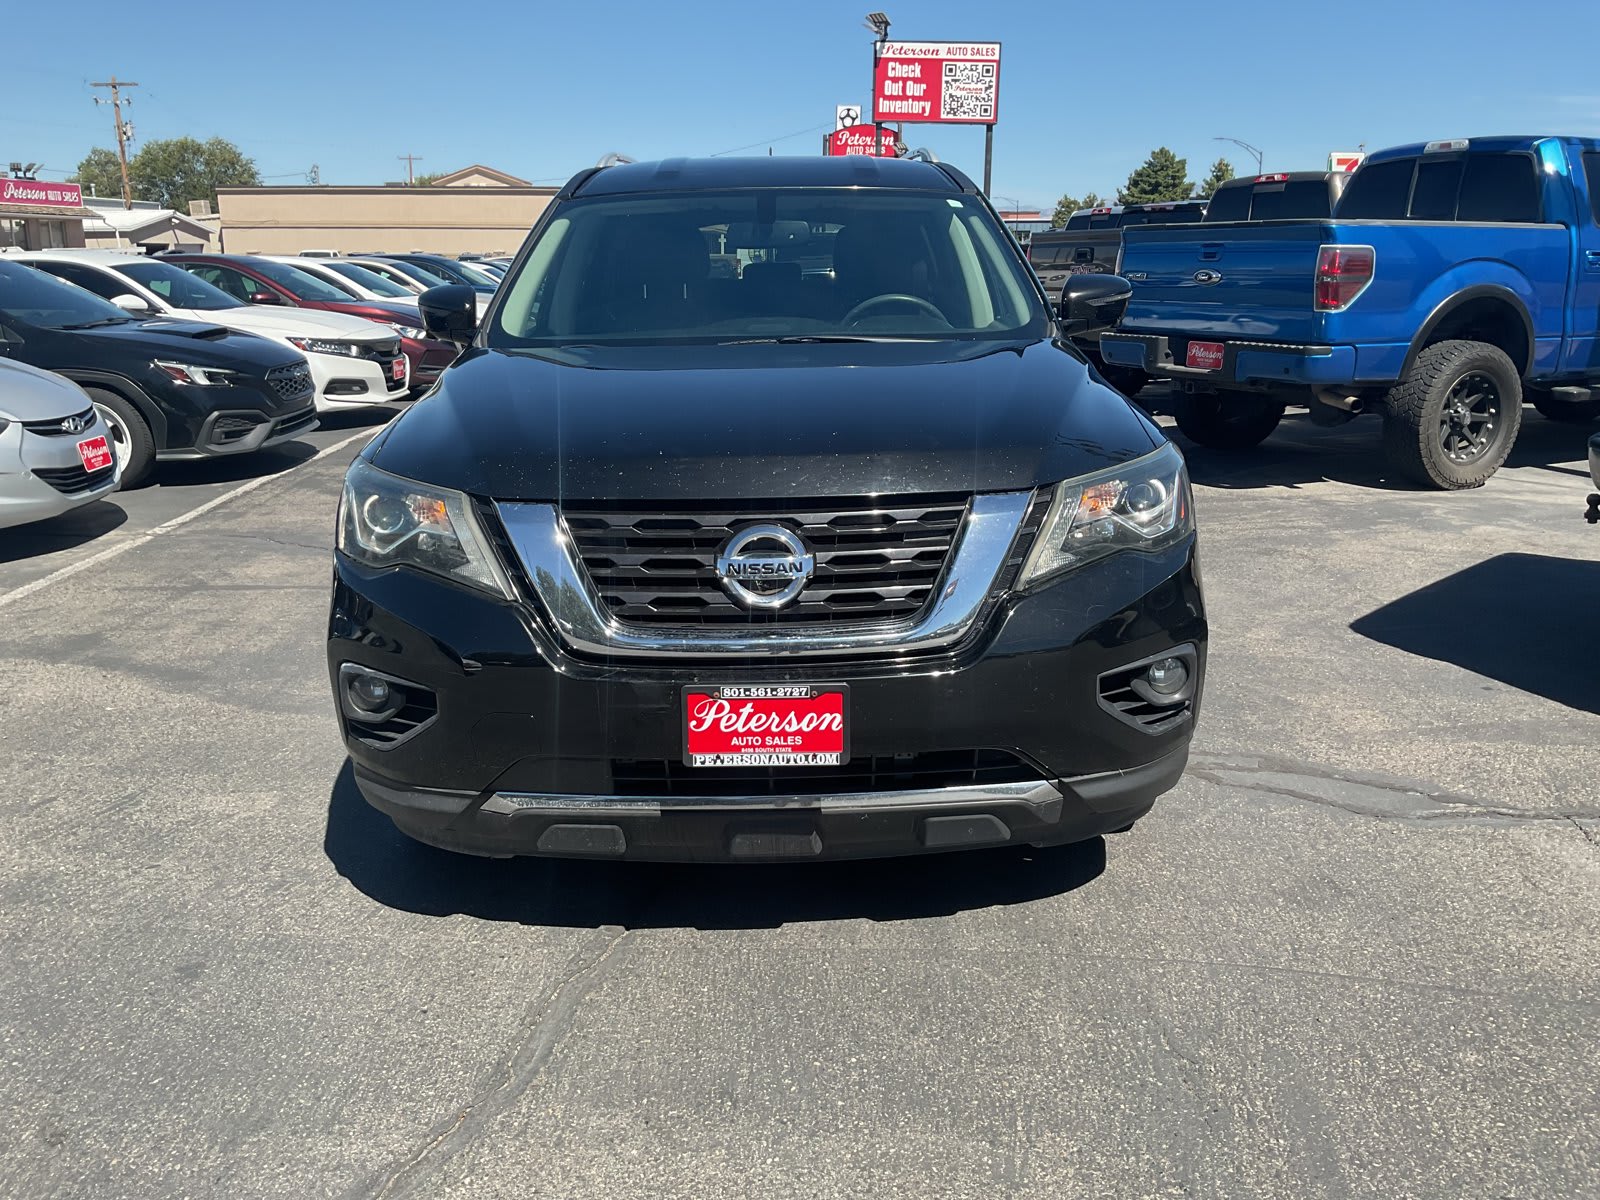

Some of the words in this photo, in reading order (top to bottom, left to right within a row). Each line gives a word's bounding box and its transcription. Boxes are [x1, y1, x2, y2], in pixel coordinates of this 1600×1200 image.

[881, 44, 940, 56] Peterson
[946, 47, 968, 56] AUTO
[970, 47, 996, 56] SALES
[887, 61, 922, 78] Check
[884, 80, 903, 96] Out
[906, 80, 927, 96] Our
[878, 97, 931, 117] Inventory
[846, 146, 864, 155] AUTO
[865, 146, 886, 154] SALS
[3, 181, 47, 200] Peterson
[727, 561, 803, 575] NISSAN
[723, 687, 808, 697] 801-561-2727
[689, 699, 843, 733] Peterson
[731, 737, 762, 746] AUTO
[765, 736, 803, 745] SALES
